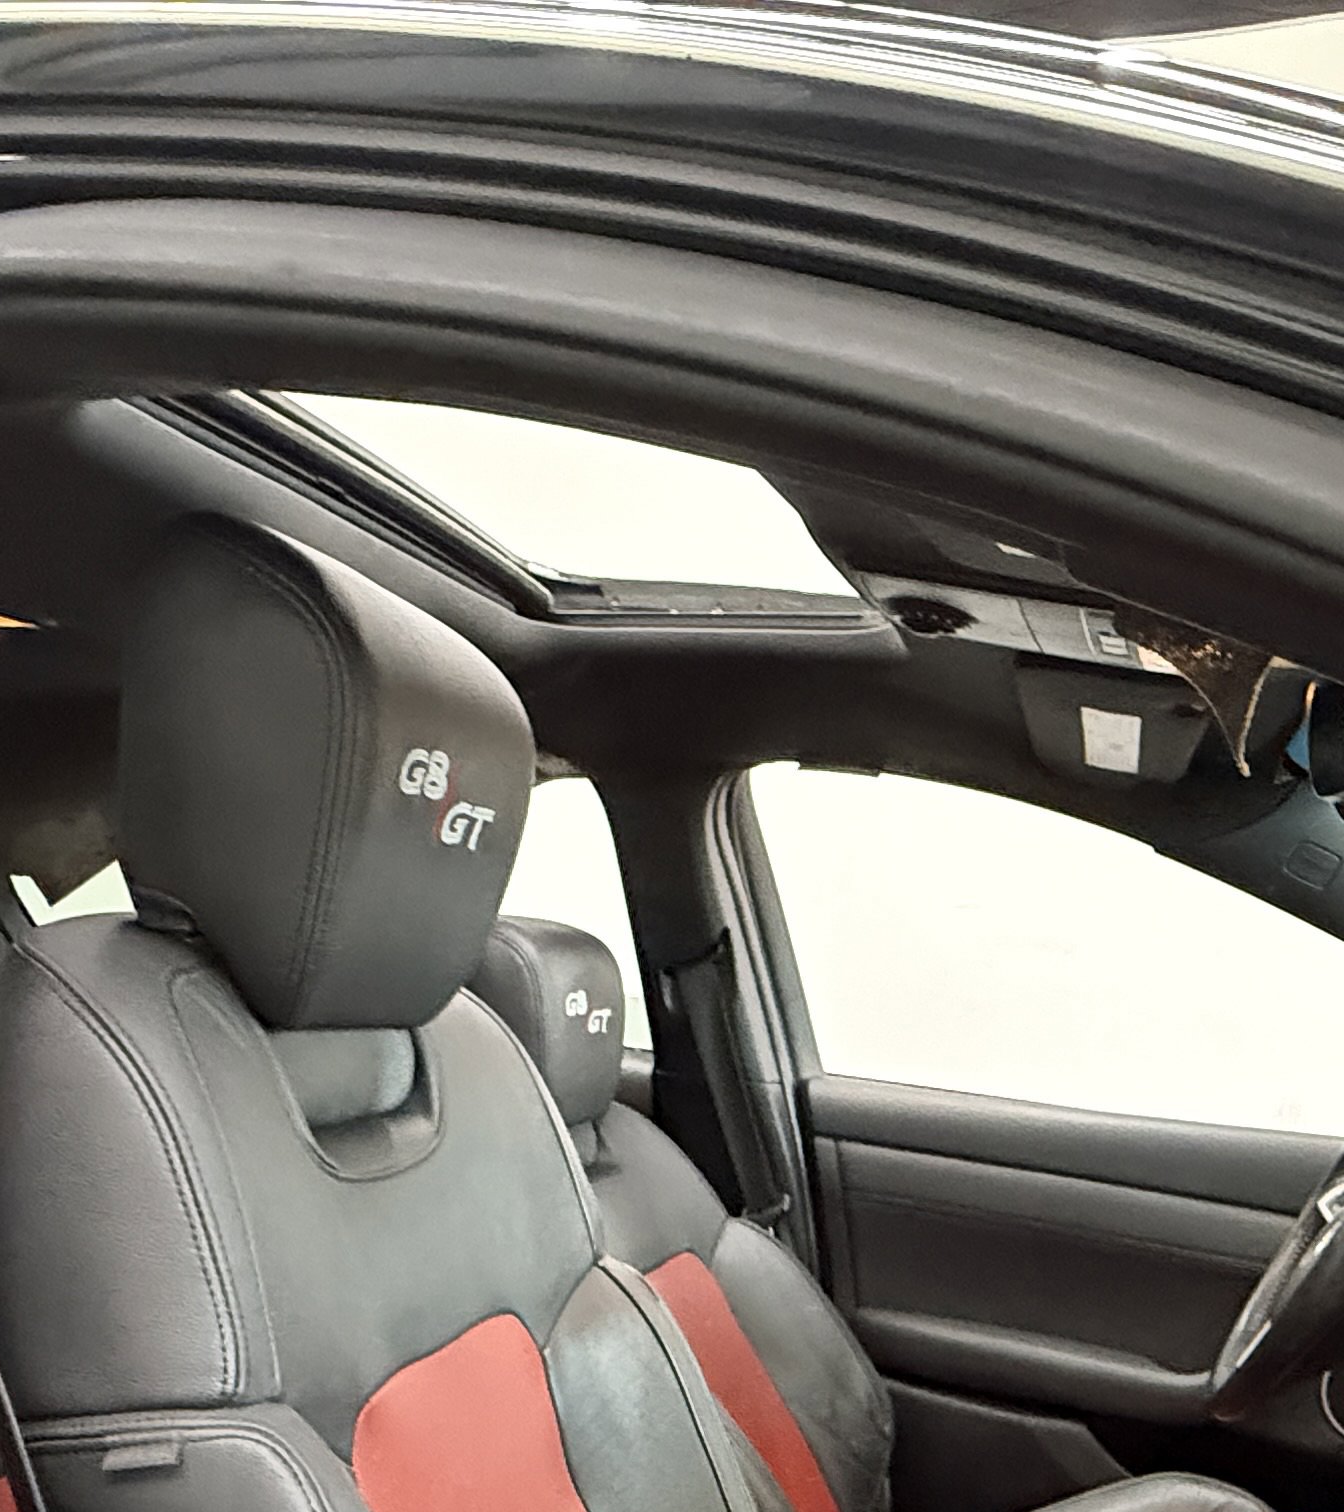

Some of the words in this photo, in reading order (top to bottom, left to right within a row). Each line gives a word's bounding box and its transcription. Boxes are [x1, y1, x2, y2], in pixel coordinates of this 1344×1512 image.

[399, 748, 450, 800] G8
[440, 801, 496, 851] GT
[565, 989, 588, 1016] G8
[588, 1008, 612, 1034] GT
